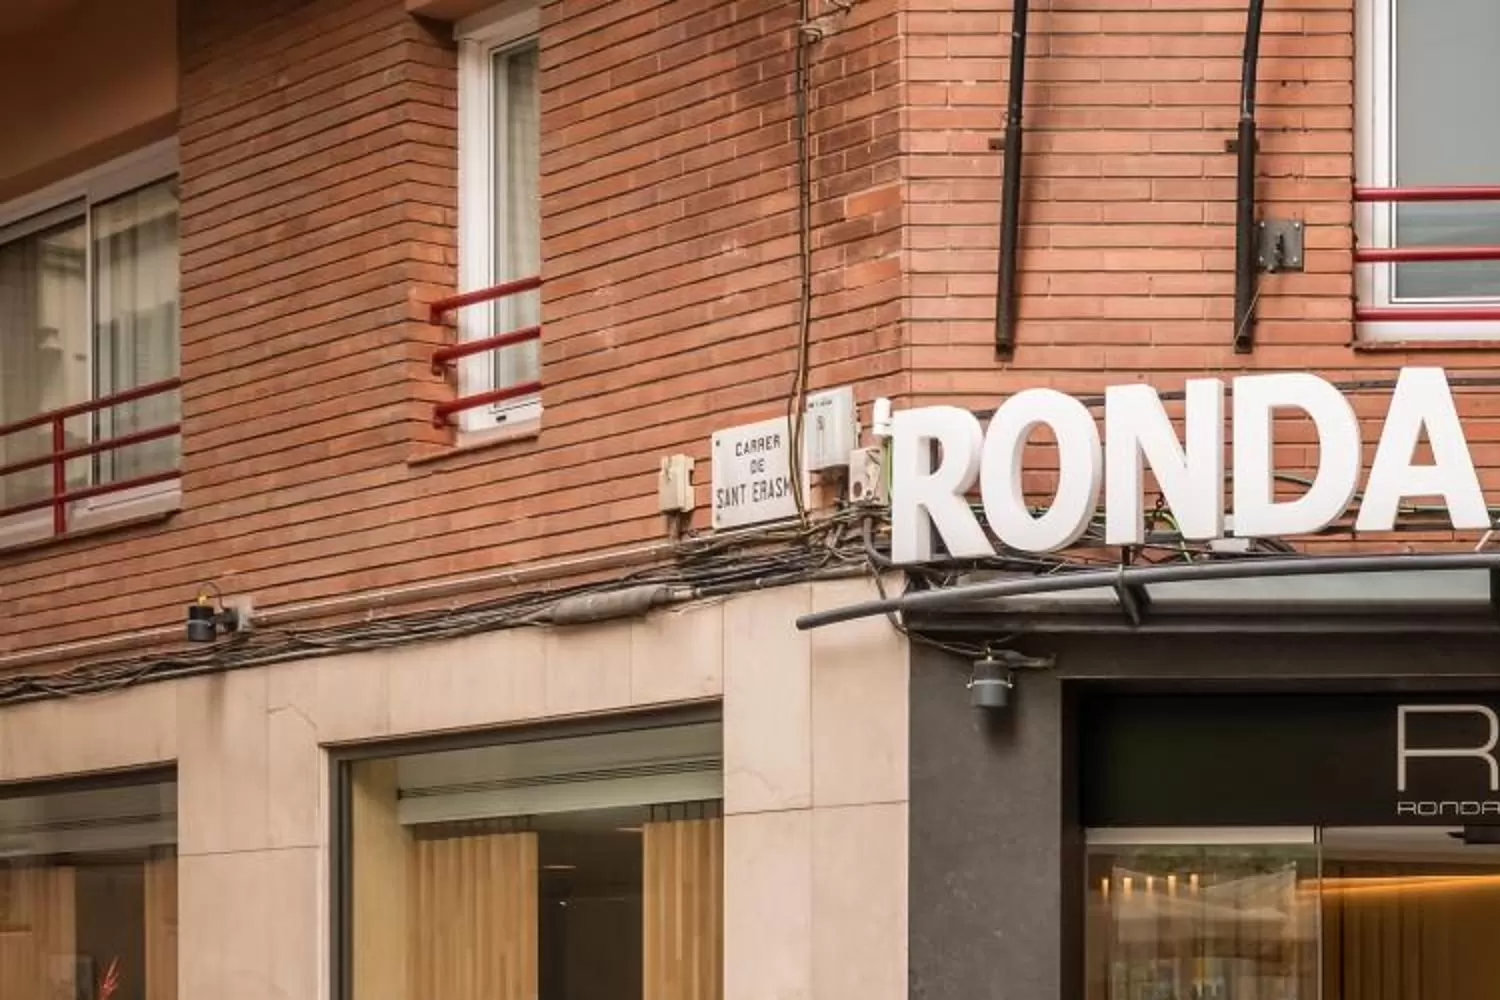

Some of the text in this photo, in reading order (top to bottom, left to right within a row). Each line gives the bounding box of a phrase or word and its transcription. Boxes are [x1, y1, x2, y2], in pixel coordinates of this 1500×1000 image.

[735, 433, 781, 457] CARRER
[750, 458, 765, 475] DE
[891, 366, 1493, 564] RONDA
[716, 476, 795, 509] SANT ERASM
